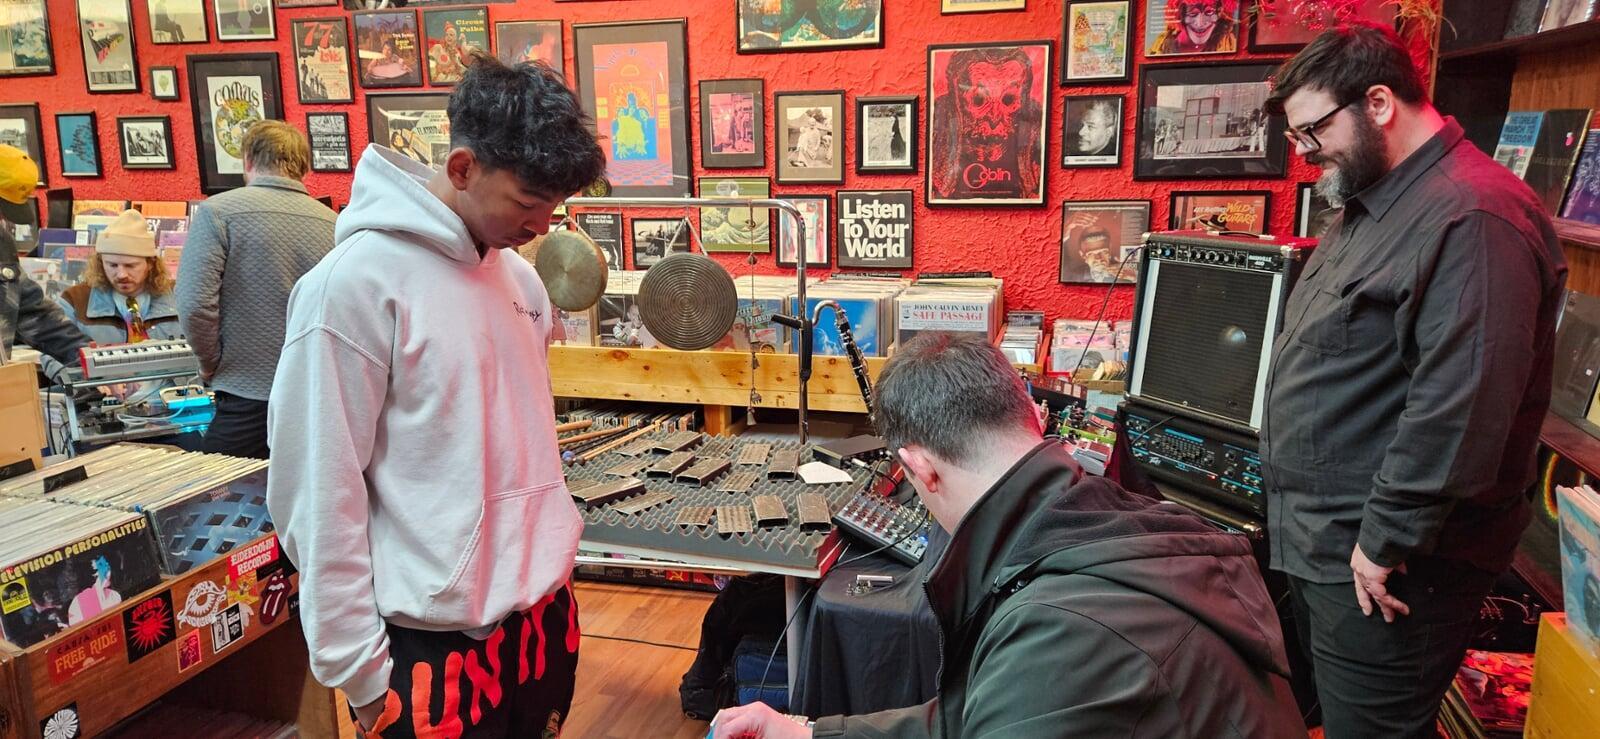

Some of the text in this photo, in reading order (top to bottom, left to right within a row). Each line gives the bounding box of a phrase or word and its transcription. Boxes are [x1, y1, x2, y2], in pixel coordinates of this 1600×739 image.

[303, 22, 334, 49] 77
[963, 163, 1012, 189] Goblin
[843, 198, 905, 219] Listen
[840, 219, 909, 238] To Your
[844, 238, 905, 258] World
[913, 311, 984, 320] SAFE PASSAGE
[0, 517, 147, 583] ELEVISION PERSONALITIES
[231, 537, 275, 566] EIDERDOWN
[237, 551, 272, 576] RECORDS
[55, 646, 86, 674] FREE
[90, 630, 118, 655] RIDE
